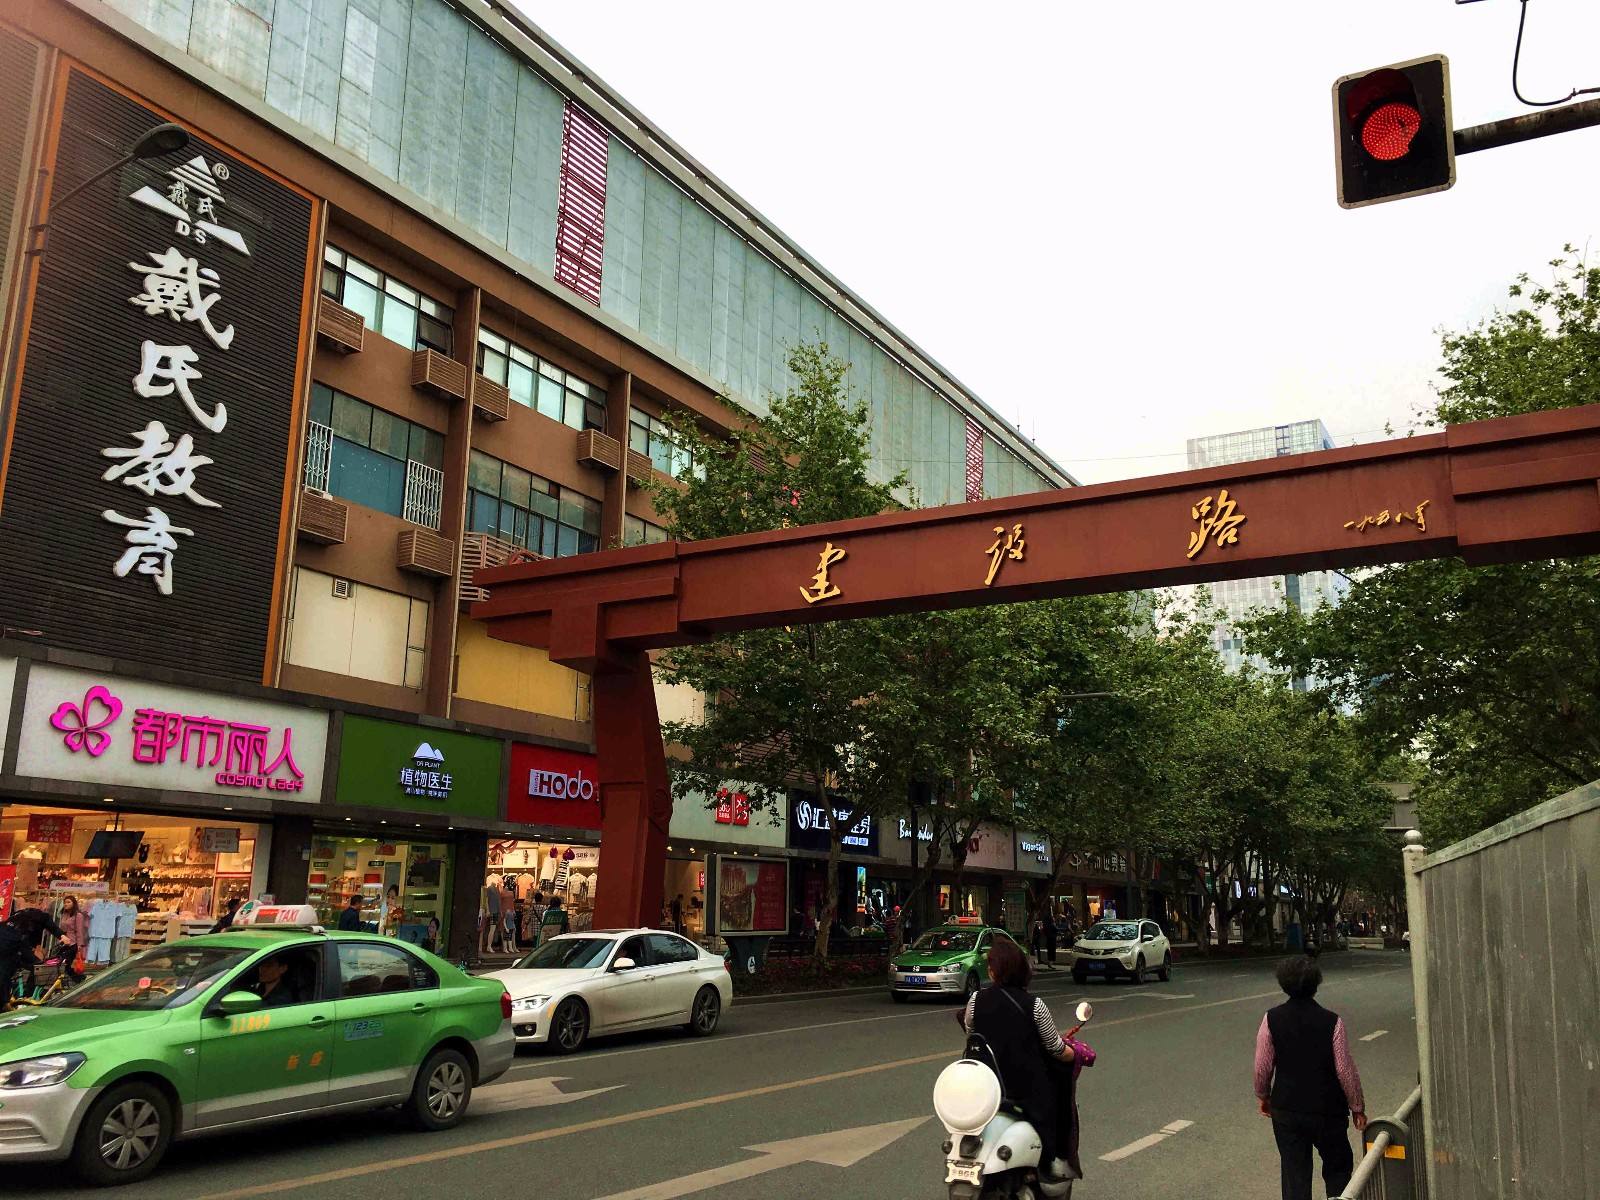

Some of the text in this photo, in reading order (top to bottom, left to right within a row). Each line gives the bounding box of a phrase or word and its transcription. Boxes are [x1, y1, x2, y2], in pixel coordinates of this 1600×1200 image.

[101, 247, 235, 595] 戴氏教育
[132, 708, 304, 778] 都市丽人
[400, 767, 453, 791] 植物医生
[280, 908, 300, 923] TAXI
